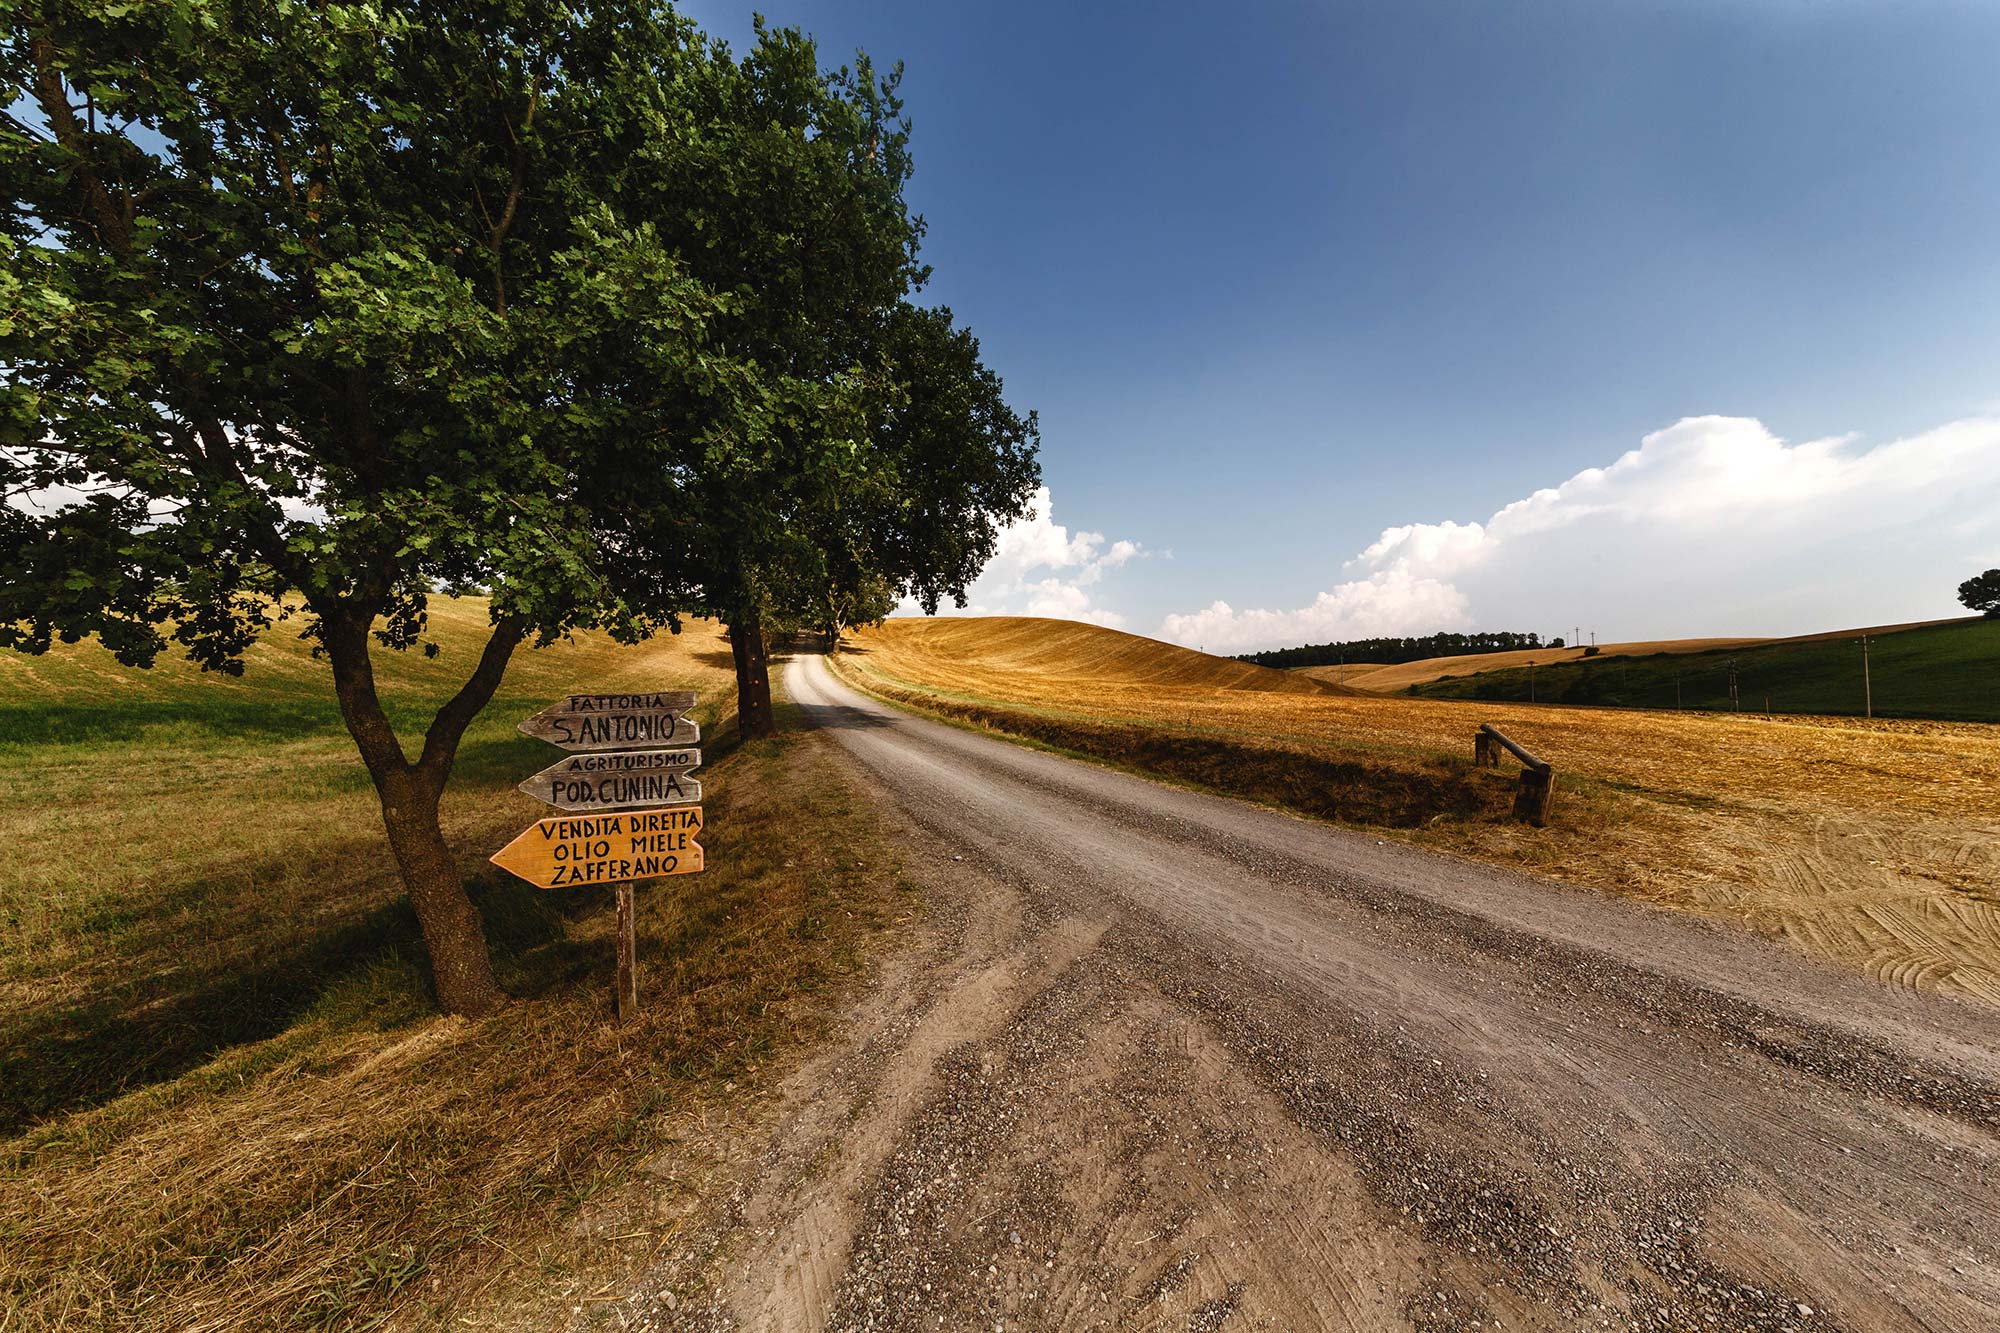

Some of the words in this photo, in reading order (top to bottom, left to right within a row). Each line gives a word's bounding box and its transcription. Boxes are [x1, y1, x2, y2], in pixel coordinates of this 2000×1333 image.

[570, 696, 664, 711] FATTORIA
[569, 753, 689, 771] AGRITURISMO
[630, 812, 701, 833] DIRETTA
[554, 841, 610, 862] OLIO
[631, 833, 687, 854] MIELE
[551, 856, 678, 885] ZAFFERANO
